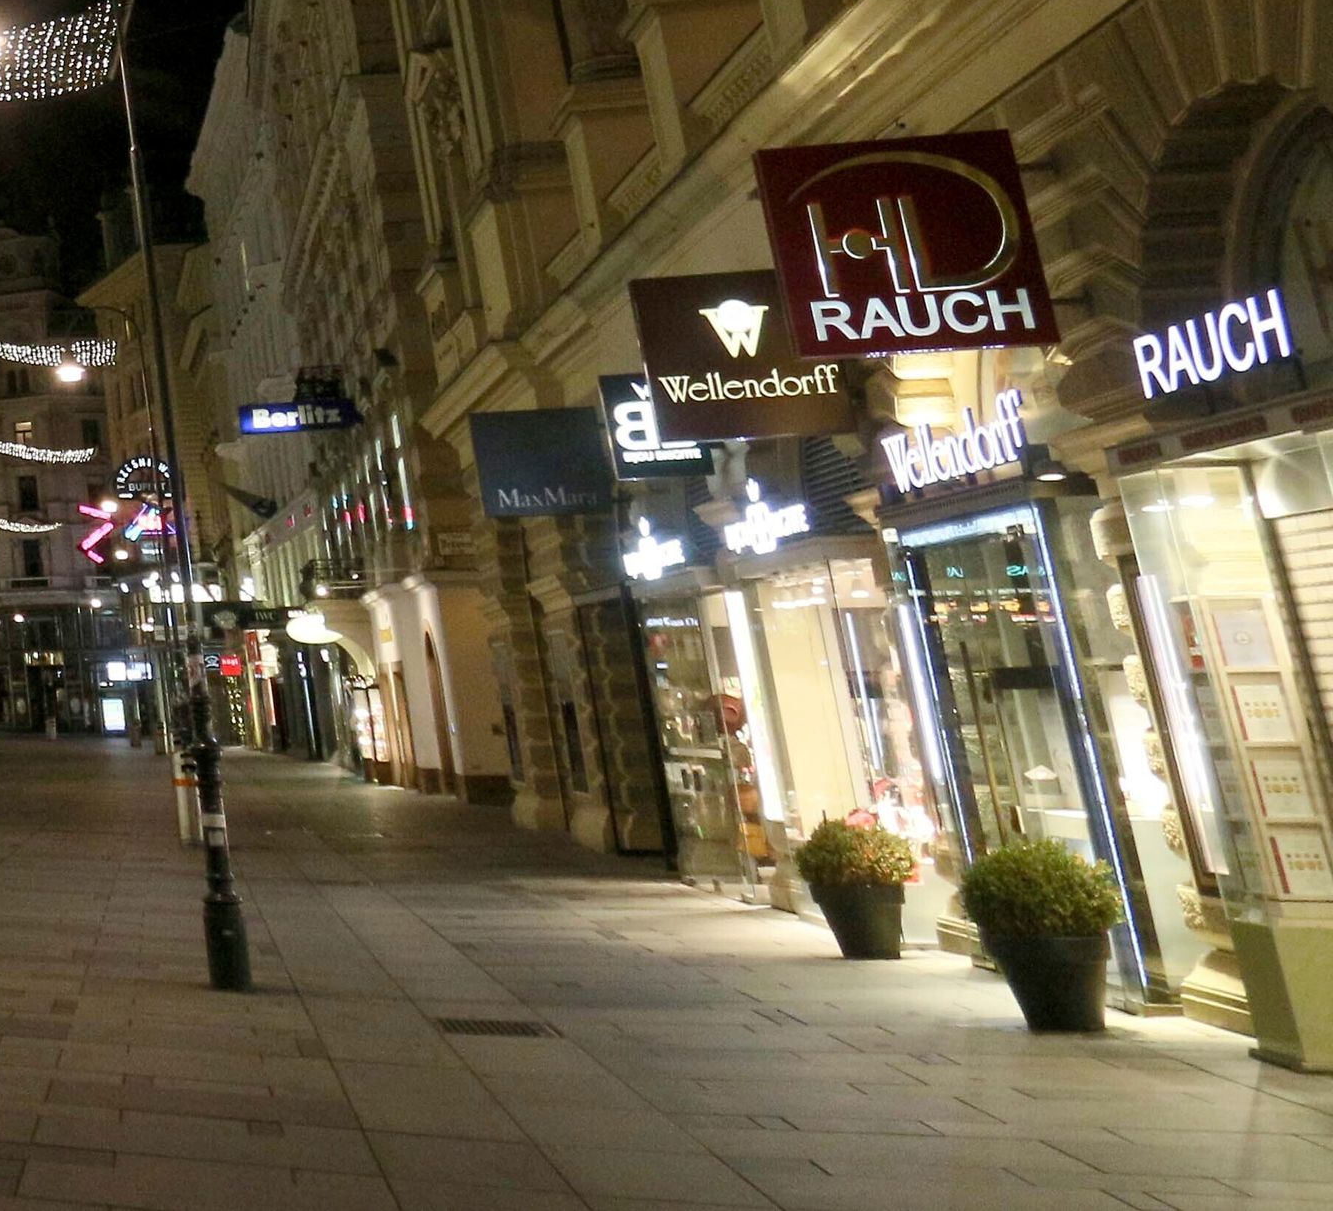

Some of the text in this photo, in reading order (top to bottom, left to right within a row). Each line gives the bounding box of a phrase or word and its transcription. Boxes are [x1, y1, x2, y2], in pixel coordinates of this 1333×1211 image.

[809, 288, 1036, 342] RAUCH
[1133, 289, 1291, 400] RAUCH
[658, 364, 839, 404] Wellendorff
[252, 404, 342, 429] Berlitz
[880, 389, 1024, 493] Wellendorff
[498, 486, 598, 509] MaxMara
